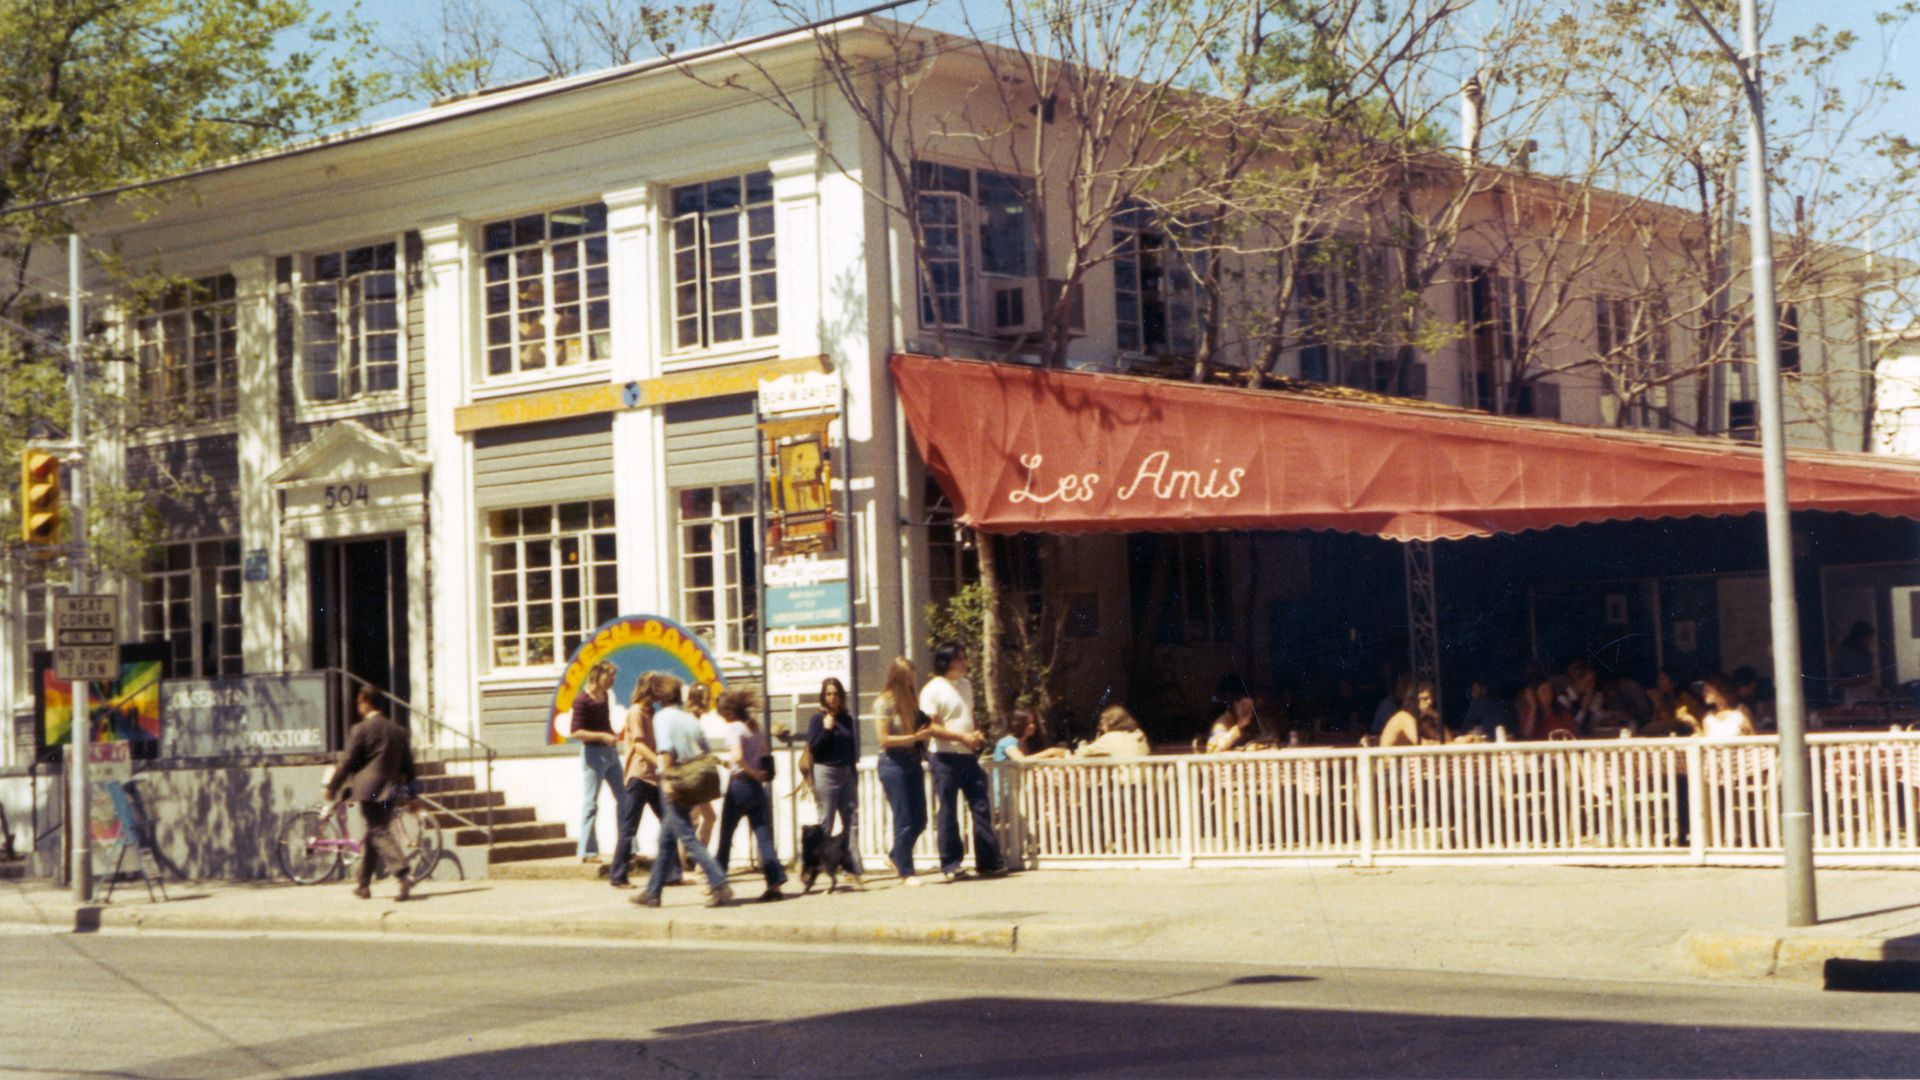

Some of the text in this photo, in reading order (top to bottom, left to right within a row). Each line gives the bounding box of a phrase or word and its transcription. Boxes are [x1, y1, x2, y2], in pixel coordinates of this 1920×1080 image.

[1008, 451, 1245, 503] Les Amis
[325, 483, 369, 510] 504
[68, 598, 102, 612] NEXT
[60, 613, 111, 626] CORNER
[773, 634, 807, 645] FRESH
[58, 647, 114, 661] NO RIGHT
[67, 662, 105, 676] TURN
[555, 621, 631, 713] FRESH
[775, 654, 846, 673] OBSERVER
